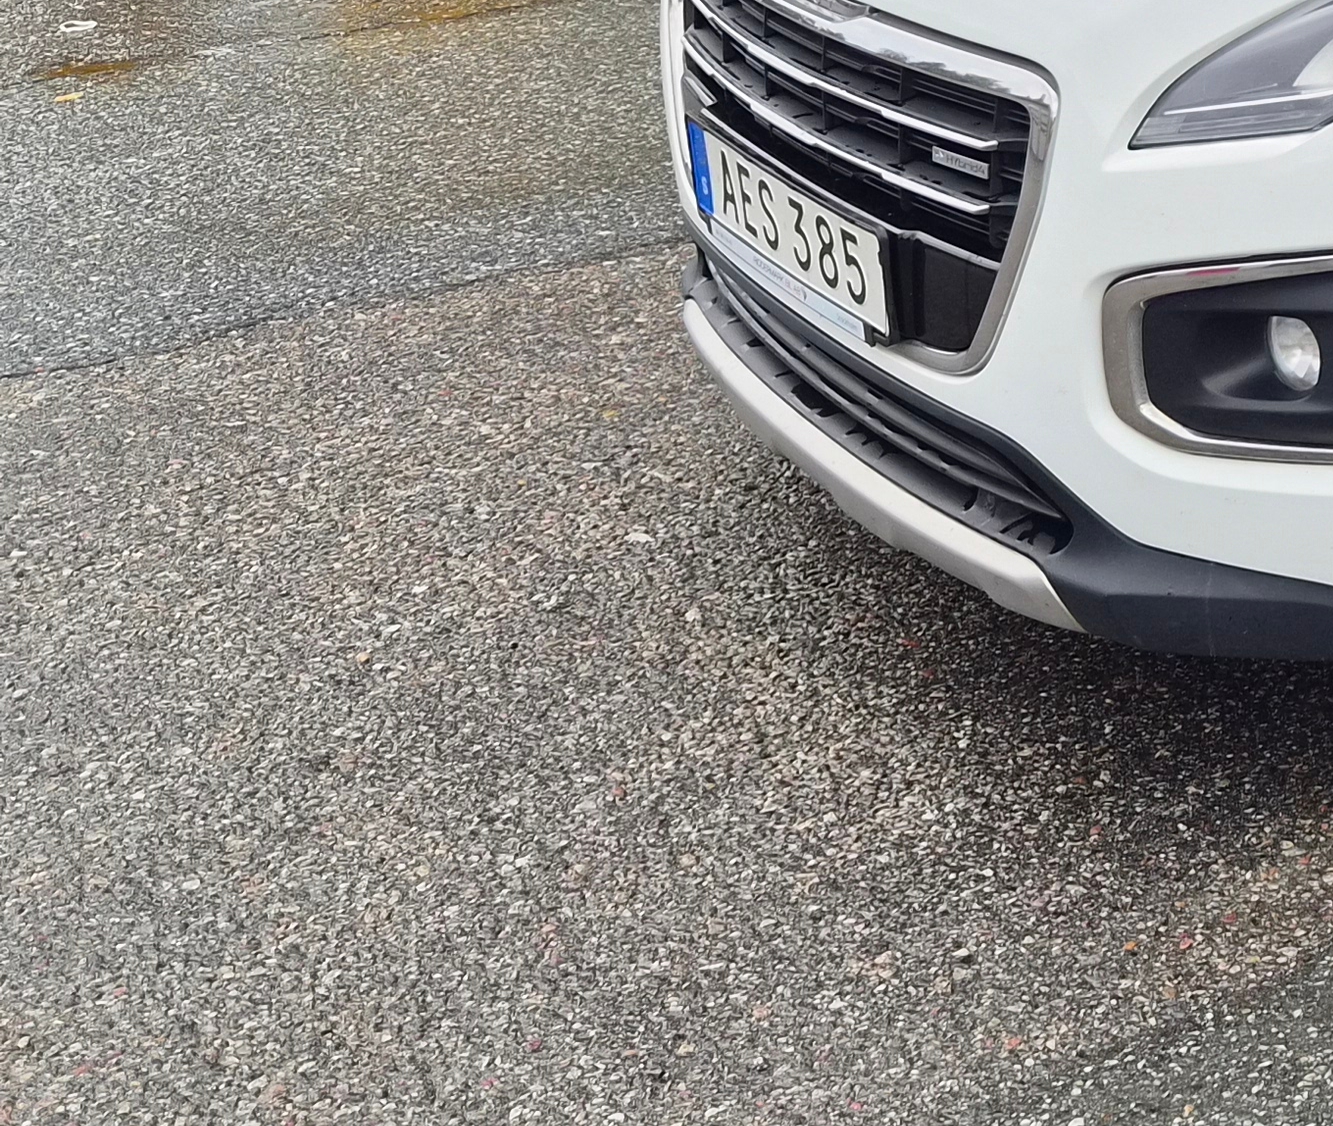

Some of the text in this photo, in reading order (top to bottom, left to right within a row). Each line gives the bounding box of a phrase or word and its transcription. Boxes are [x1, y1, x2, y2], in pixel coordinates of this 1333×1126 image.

[702, 175, 709, 195] S
[720, 148, 867, 305] AES 385
